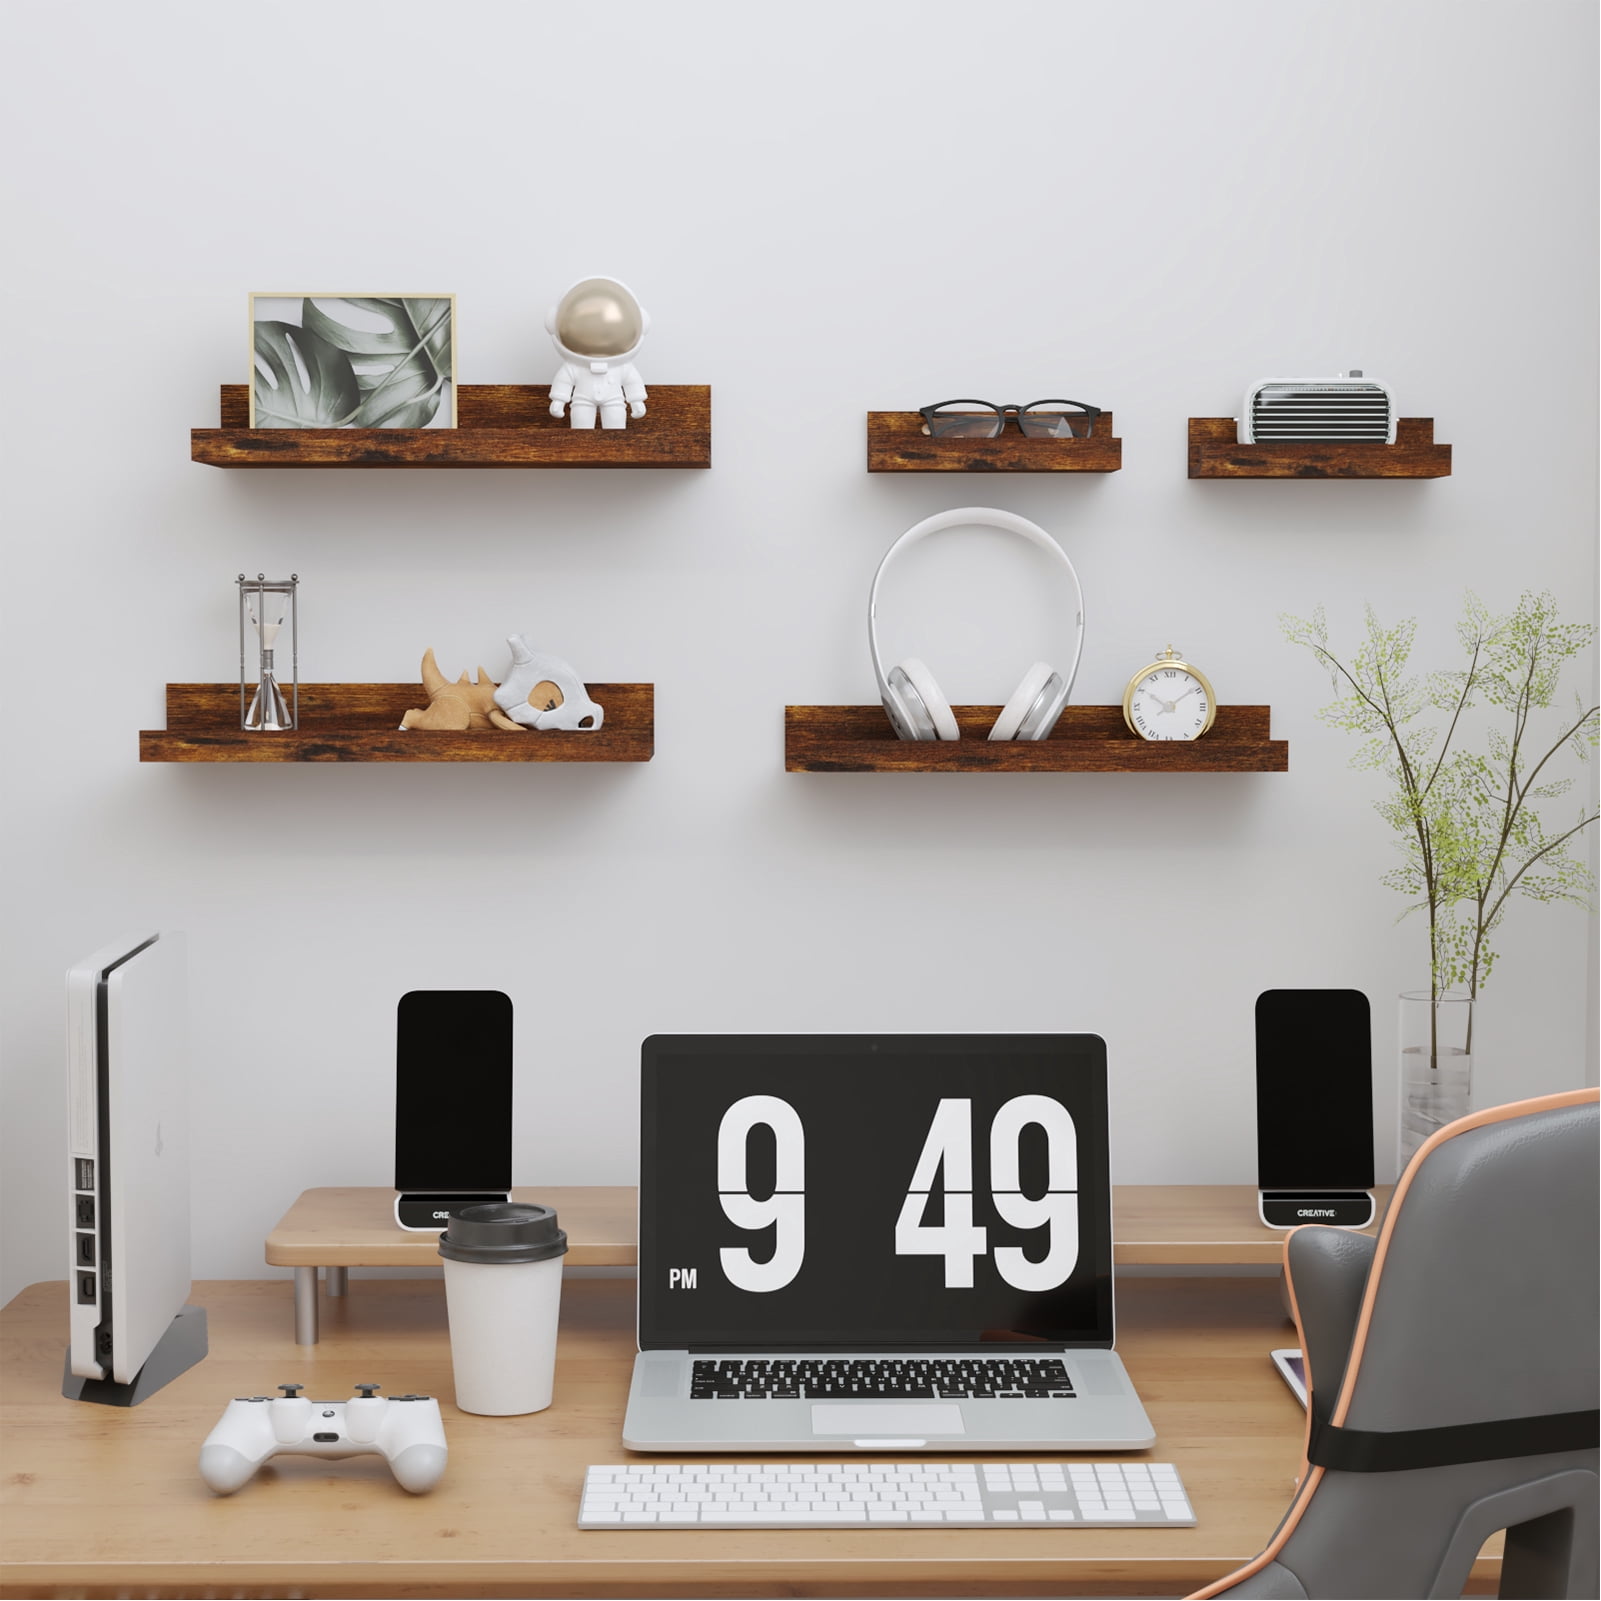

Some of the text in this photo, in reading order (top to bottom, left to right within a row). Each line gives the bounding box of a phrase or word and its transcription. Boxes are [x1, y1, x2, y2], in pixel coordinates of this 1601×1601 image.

[1149, 674, 1159, 682] XI
[1136, 715, 1147, 731] VIII
[718, 1094, 1079, 1293] 9 49
[1297, 1209, 1335, 1217] CREATIVE
[669, 1267, 698, 1290] PM
